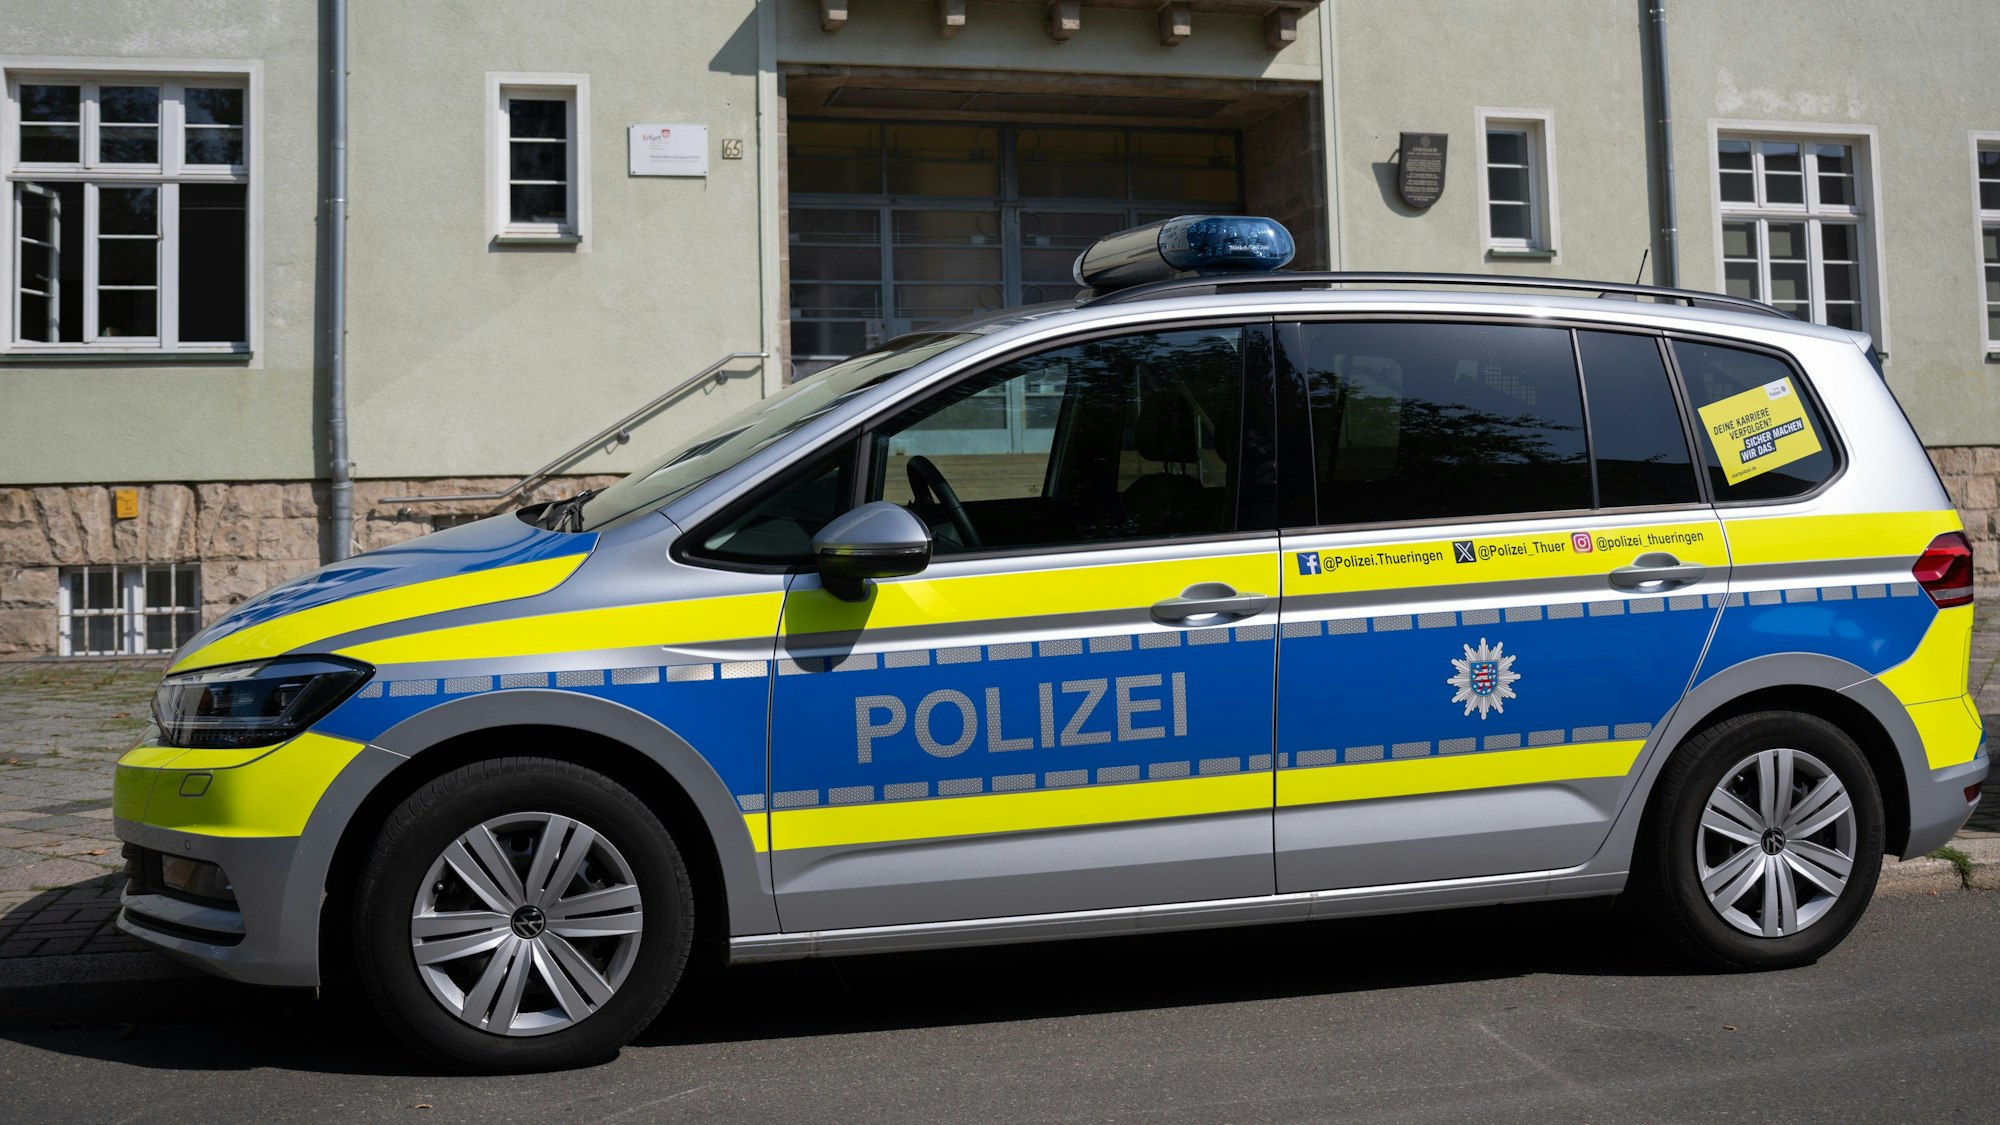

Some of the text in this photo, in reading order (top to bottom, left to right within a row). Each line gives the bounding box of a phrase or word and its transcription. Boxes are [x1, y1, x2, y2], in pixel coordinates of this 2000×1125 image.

[725, 140, 740, 157] 65
[1713, 407, 1770, 436] DEINE KARRIERE
[1729, 418, 1772, 440] VERFOLGEN?
[1745, 419, 1803, 449] SICHER MACHEN
[1741, 442, 1775, 461] WIR DAS.
[1323, 550, 1444, 572] @Polizei.Thueringen
[1478, 541, 1565, 560] @Polizei_Thuer
[1596, 531, 1704, 552] @polizei_thueringen
[855, 672, 1187, 764] POLIZEI
